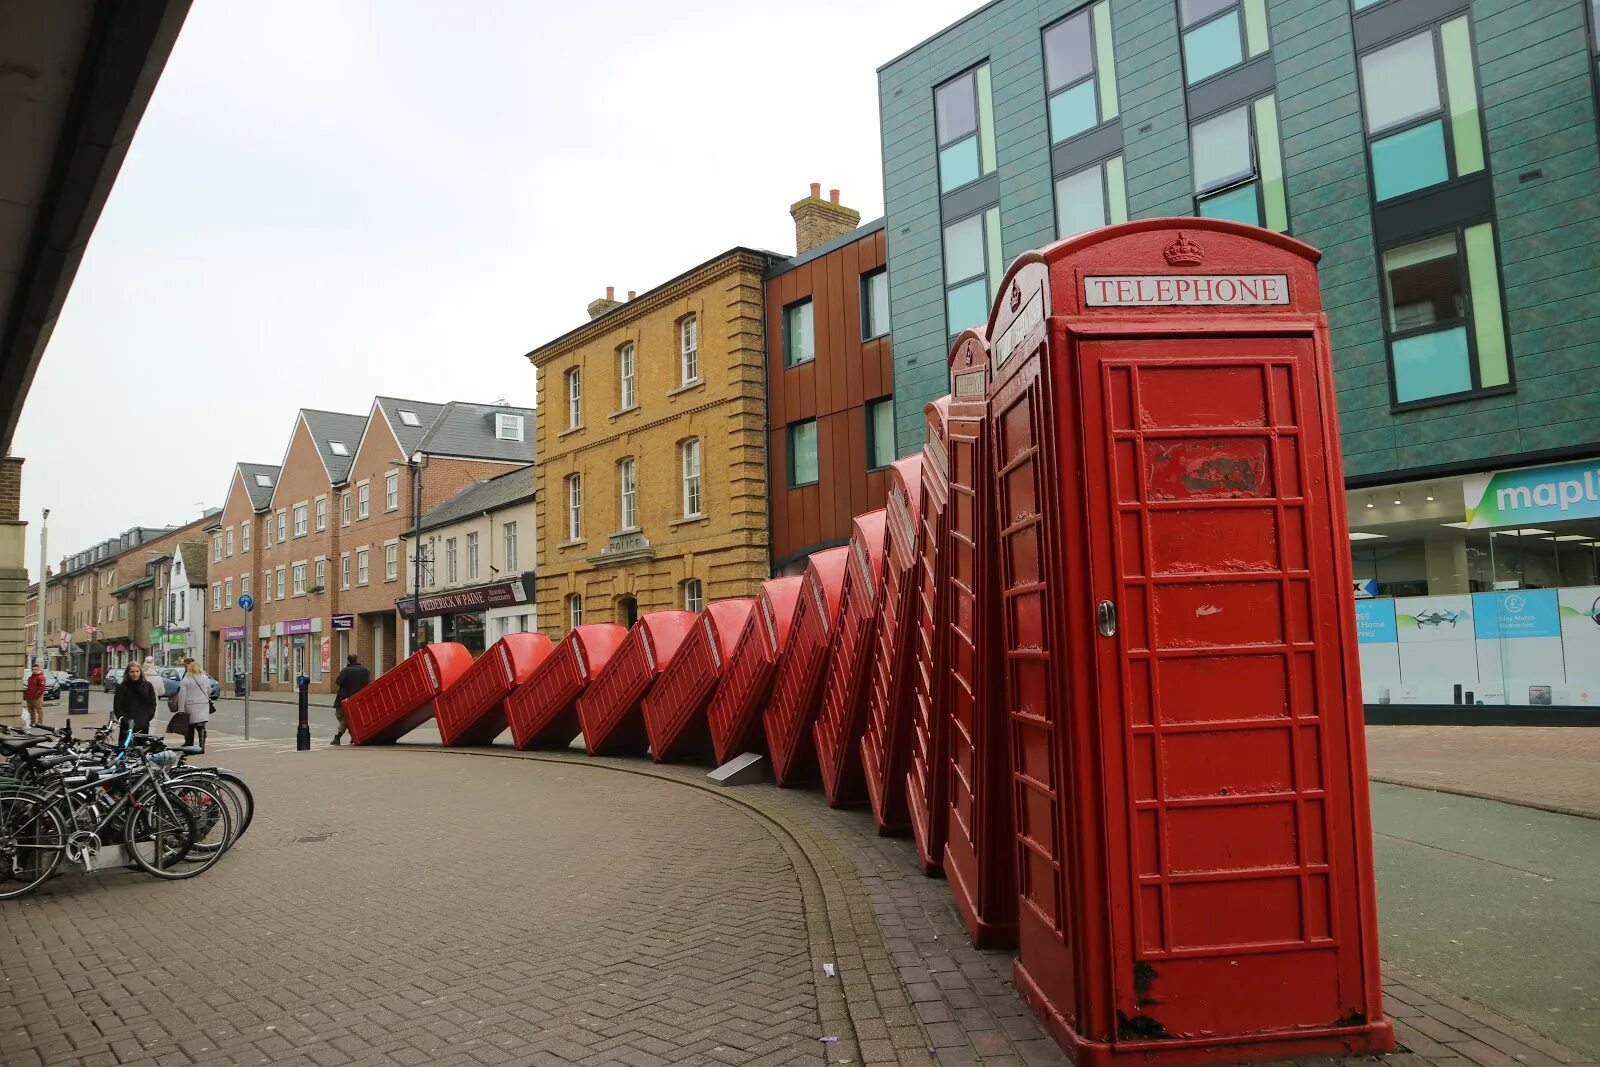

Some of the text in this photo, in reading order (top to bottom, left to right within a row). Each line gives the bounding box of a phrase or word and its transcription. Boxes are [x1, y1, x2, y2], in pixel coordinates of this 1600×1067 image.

[1095, 279, 1279, 303] TELEPHONE
[610, 539, 640, 551] POLICE
[419, 595, 456, 612] FREDERICK
[454, 594, 462, 608] W
[462, 591, 485, 606] PAINE
[1356, 613, 1370, 621] REE
[1361, 621, 1385, 629] Home
[1359, 630, 1377, 638] rvey
